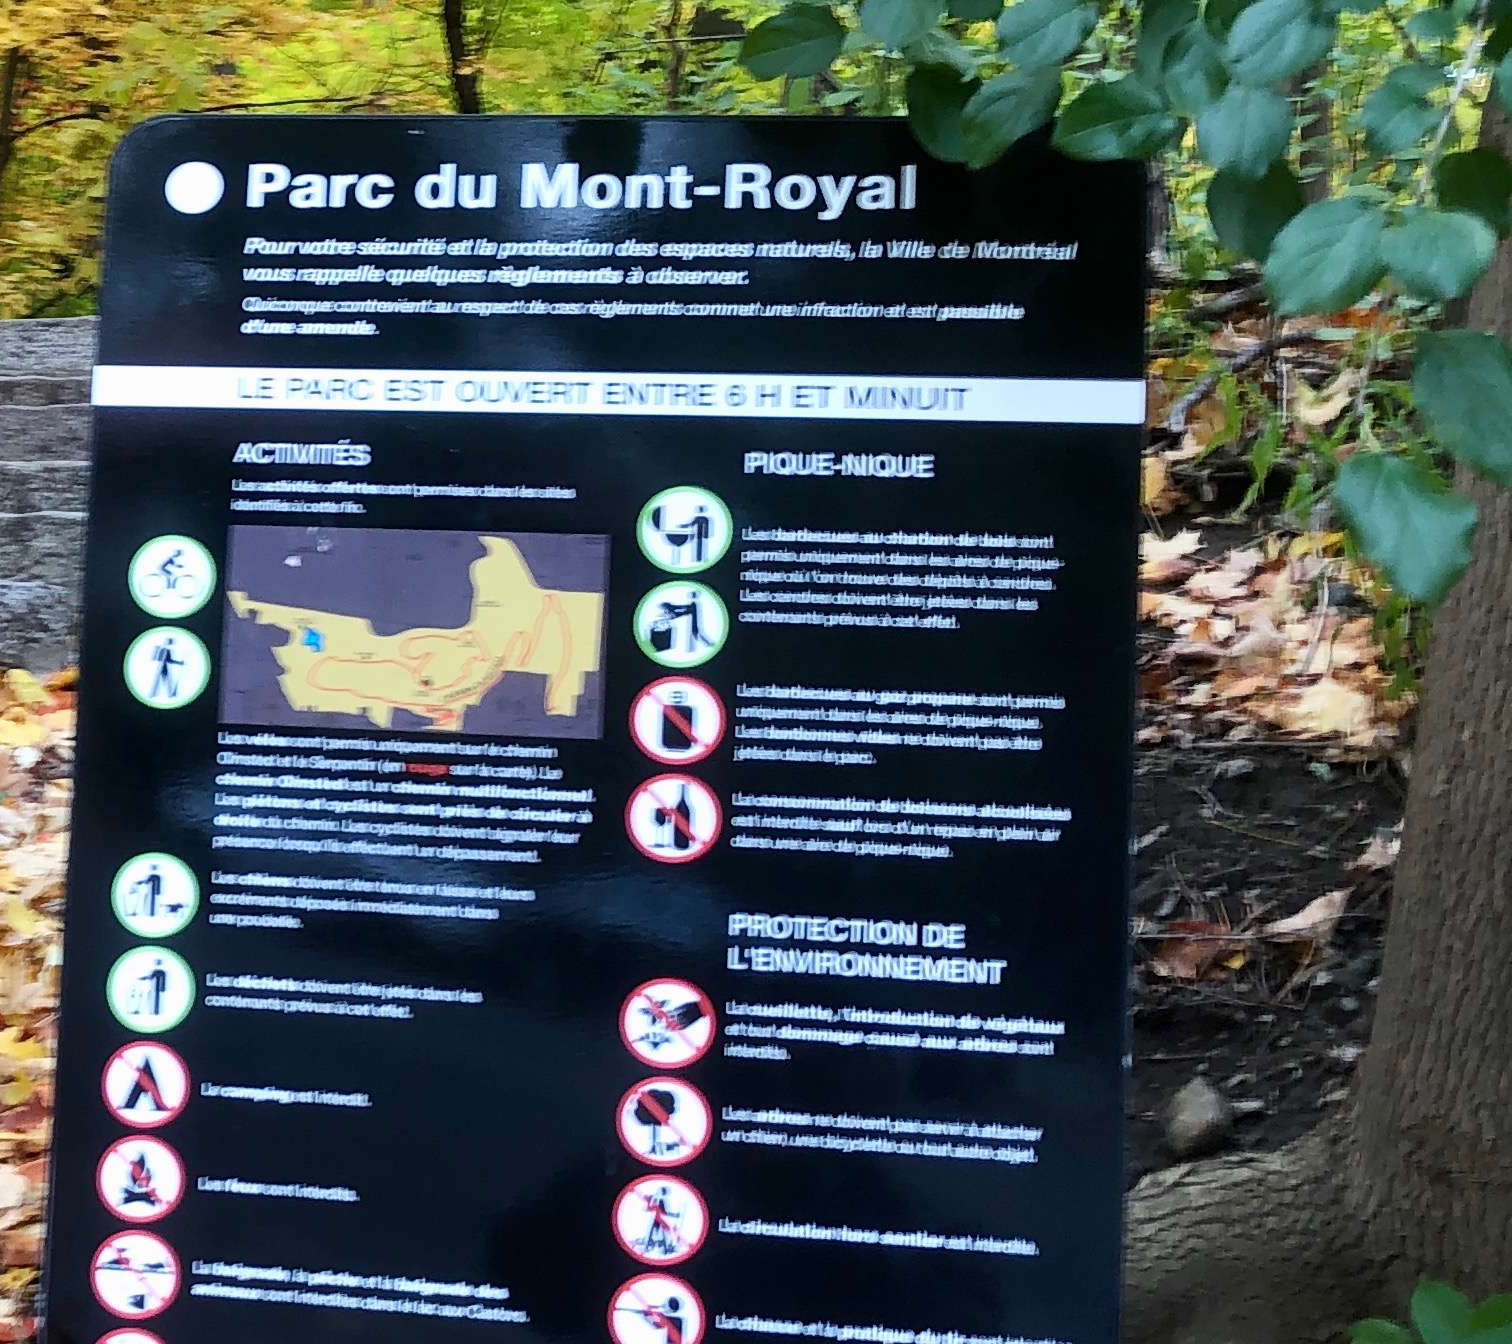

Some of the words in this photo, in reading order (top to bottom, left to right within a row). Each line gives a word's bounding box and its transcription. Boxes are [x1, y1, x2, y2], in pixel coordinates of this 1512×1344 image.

[245, 163, 395, 209] Parc
[413, 163, 497, 210] du
[519, 162, 918, 221] Mont-Royal
[886, 241, 935, 258] Ville
[938, 242, 969, 258] de
[972, 242, 1078, 260] Montréal
[238, 377, 275, 399] LE
[286, 378, 375, 401] PARC
[384, 379, 446, 402] EST
[455, 380, 593, 405] OUVERT
[602, 383, 718, 406] ENTRE
[724, 384, 745, 407] 6
[755, 384, 782, 408] H
[789, 384, 836, 408] ET
[843, 385, 973, 411] MINUIT
[232, 439, 372, 466] ACTIVITÉS
[743, 451, 935, 478] PIQUE-NIQUE
[728, 913, 918, 947] PROTECTION
[921, 922, 966, 949] DE
[727, 944, 1007, 985] L'ENVIRONNEMENT
